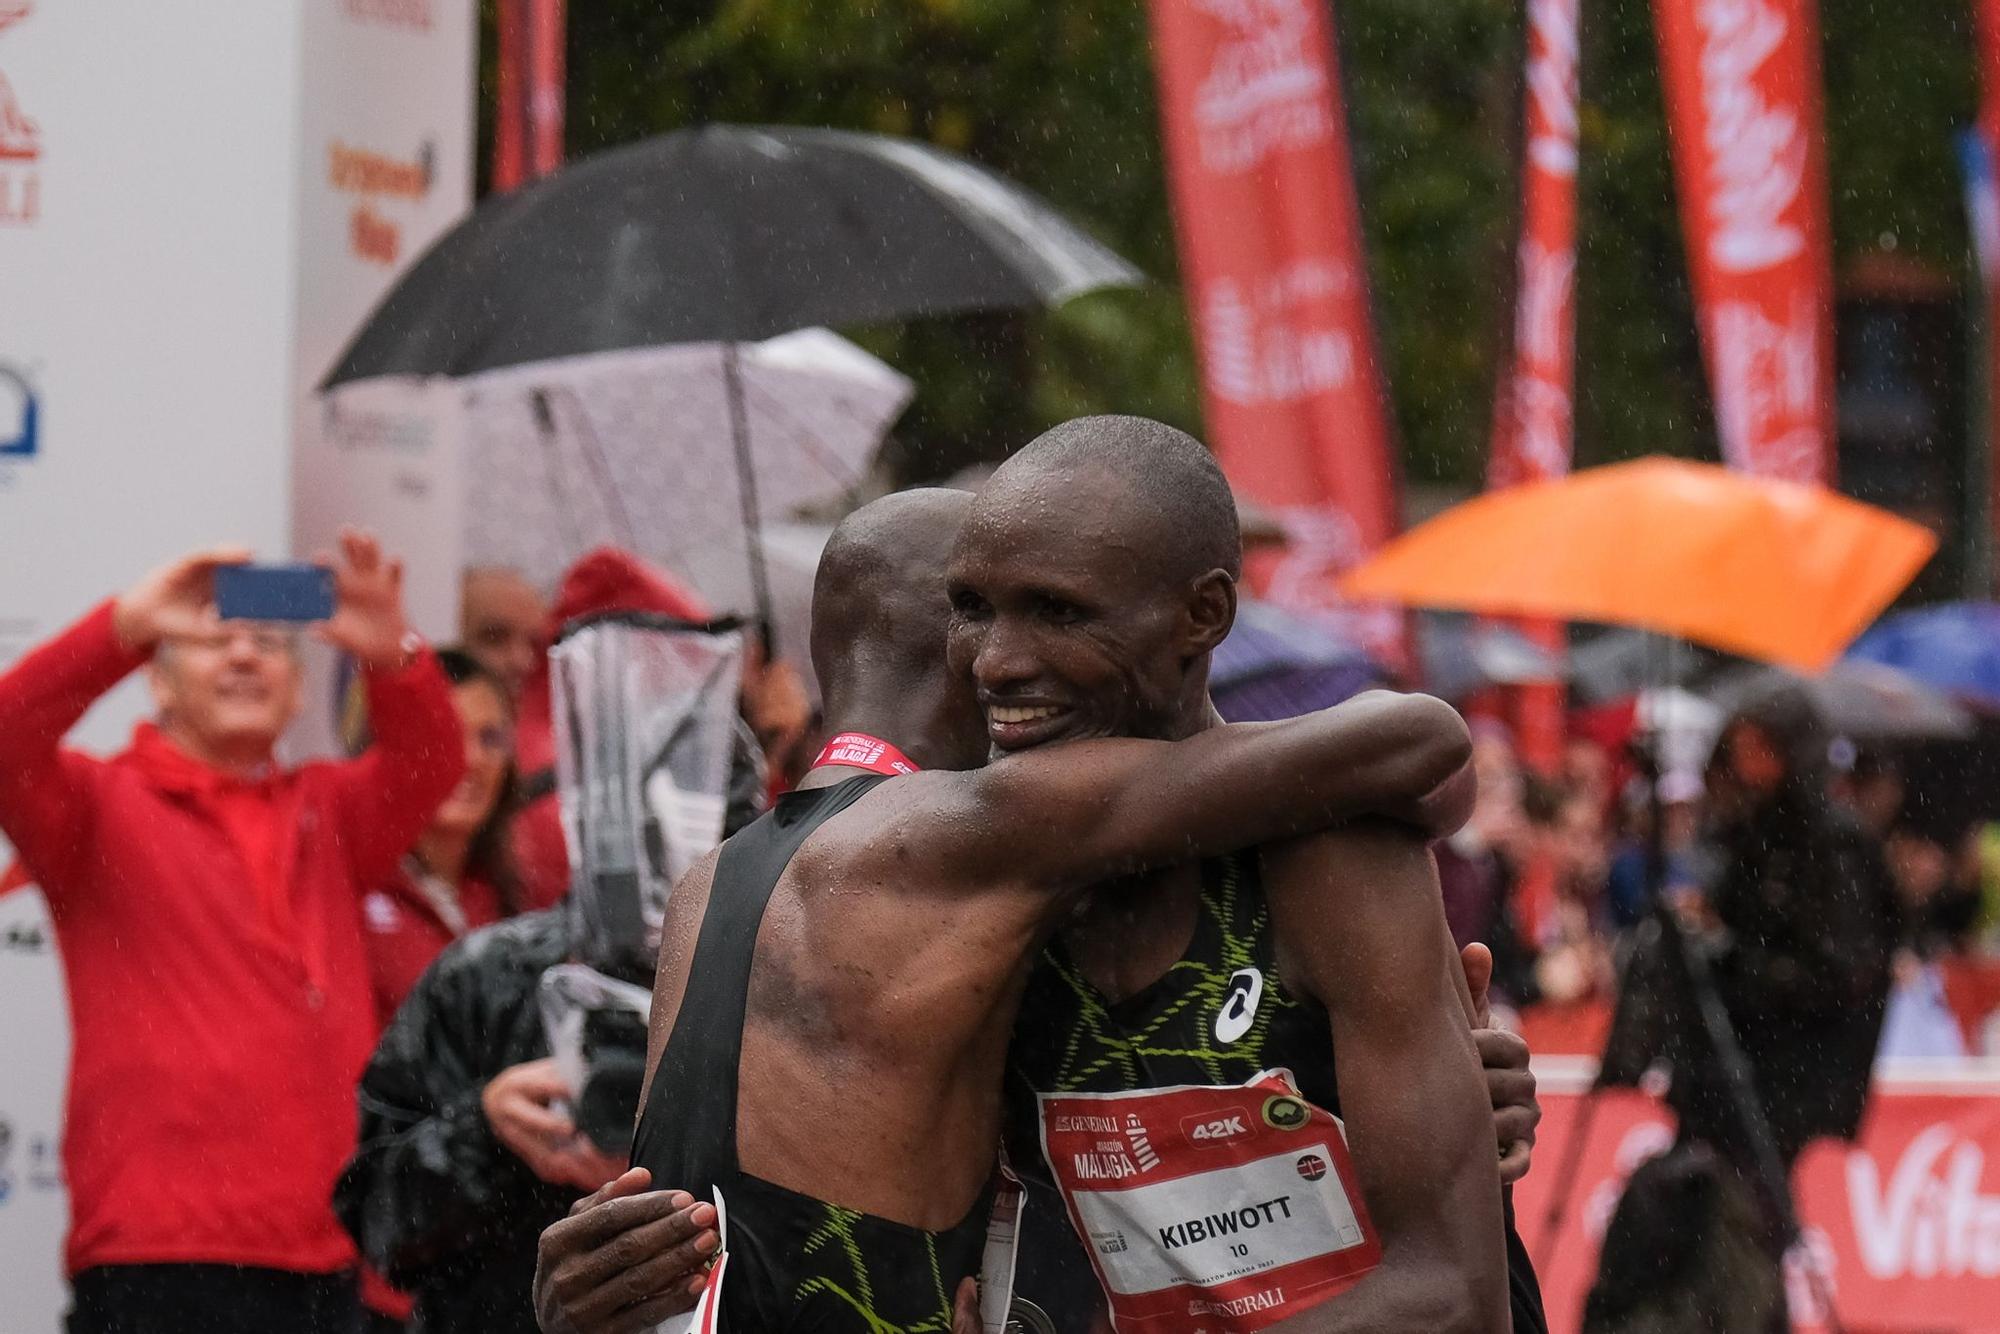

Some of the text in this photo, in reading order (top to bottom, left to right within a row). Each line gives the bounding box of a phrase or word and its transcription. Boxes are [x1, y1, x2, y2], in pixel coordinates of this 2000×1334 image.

[1070, 1115, 1120, 1133] GENERALI
[1192, 1116, 1247, 1140] 42K
[1074, 1149, 1138, 1179] MÁLAGA
[1158, 1195, 1292, 1250] KIBIWOTT
[1229, 1243, 1249, 1258] 10
